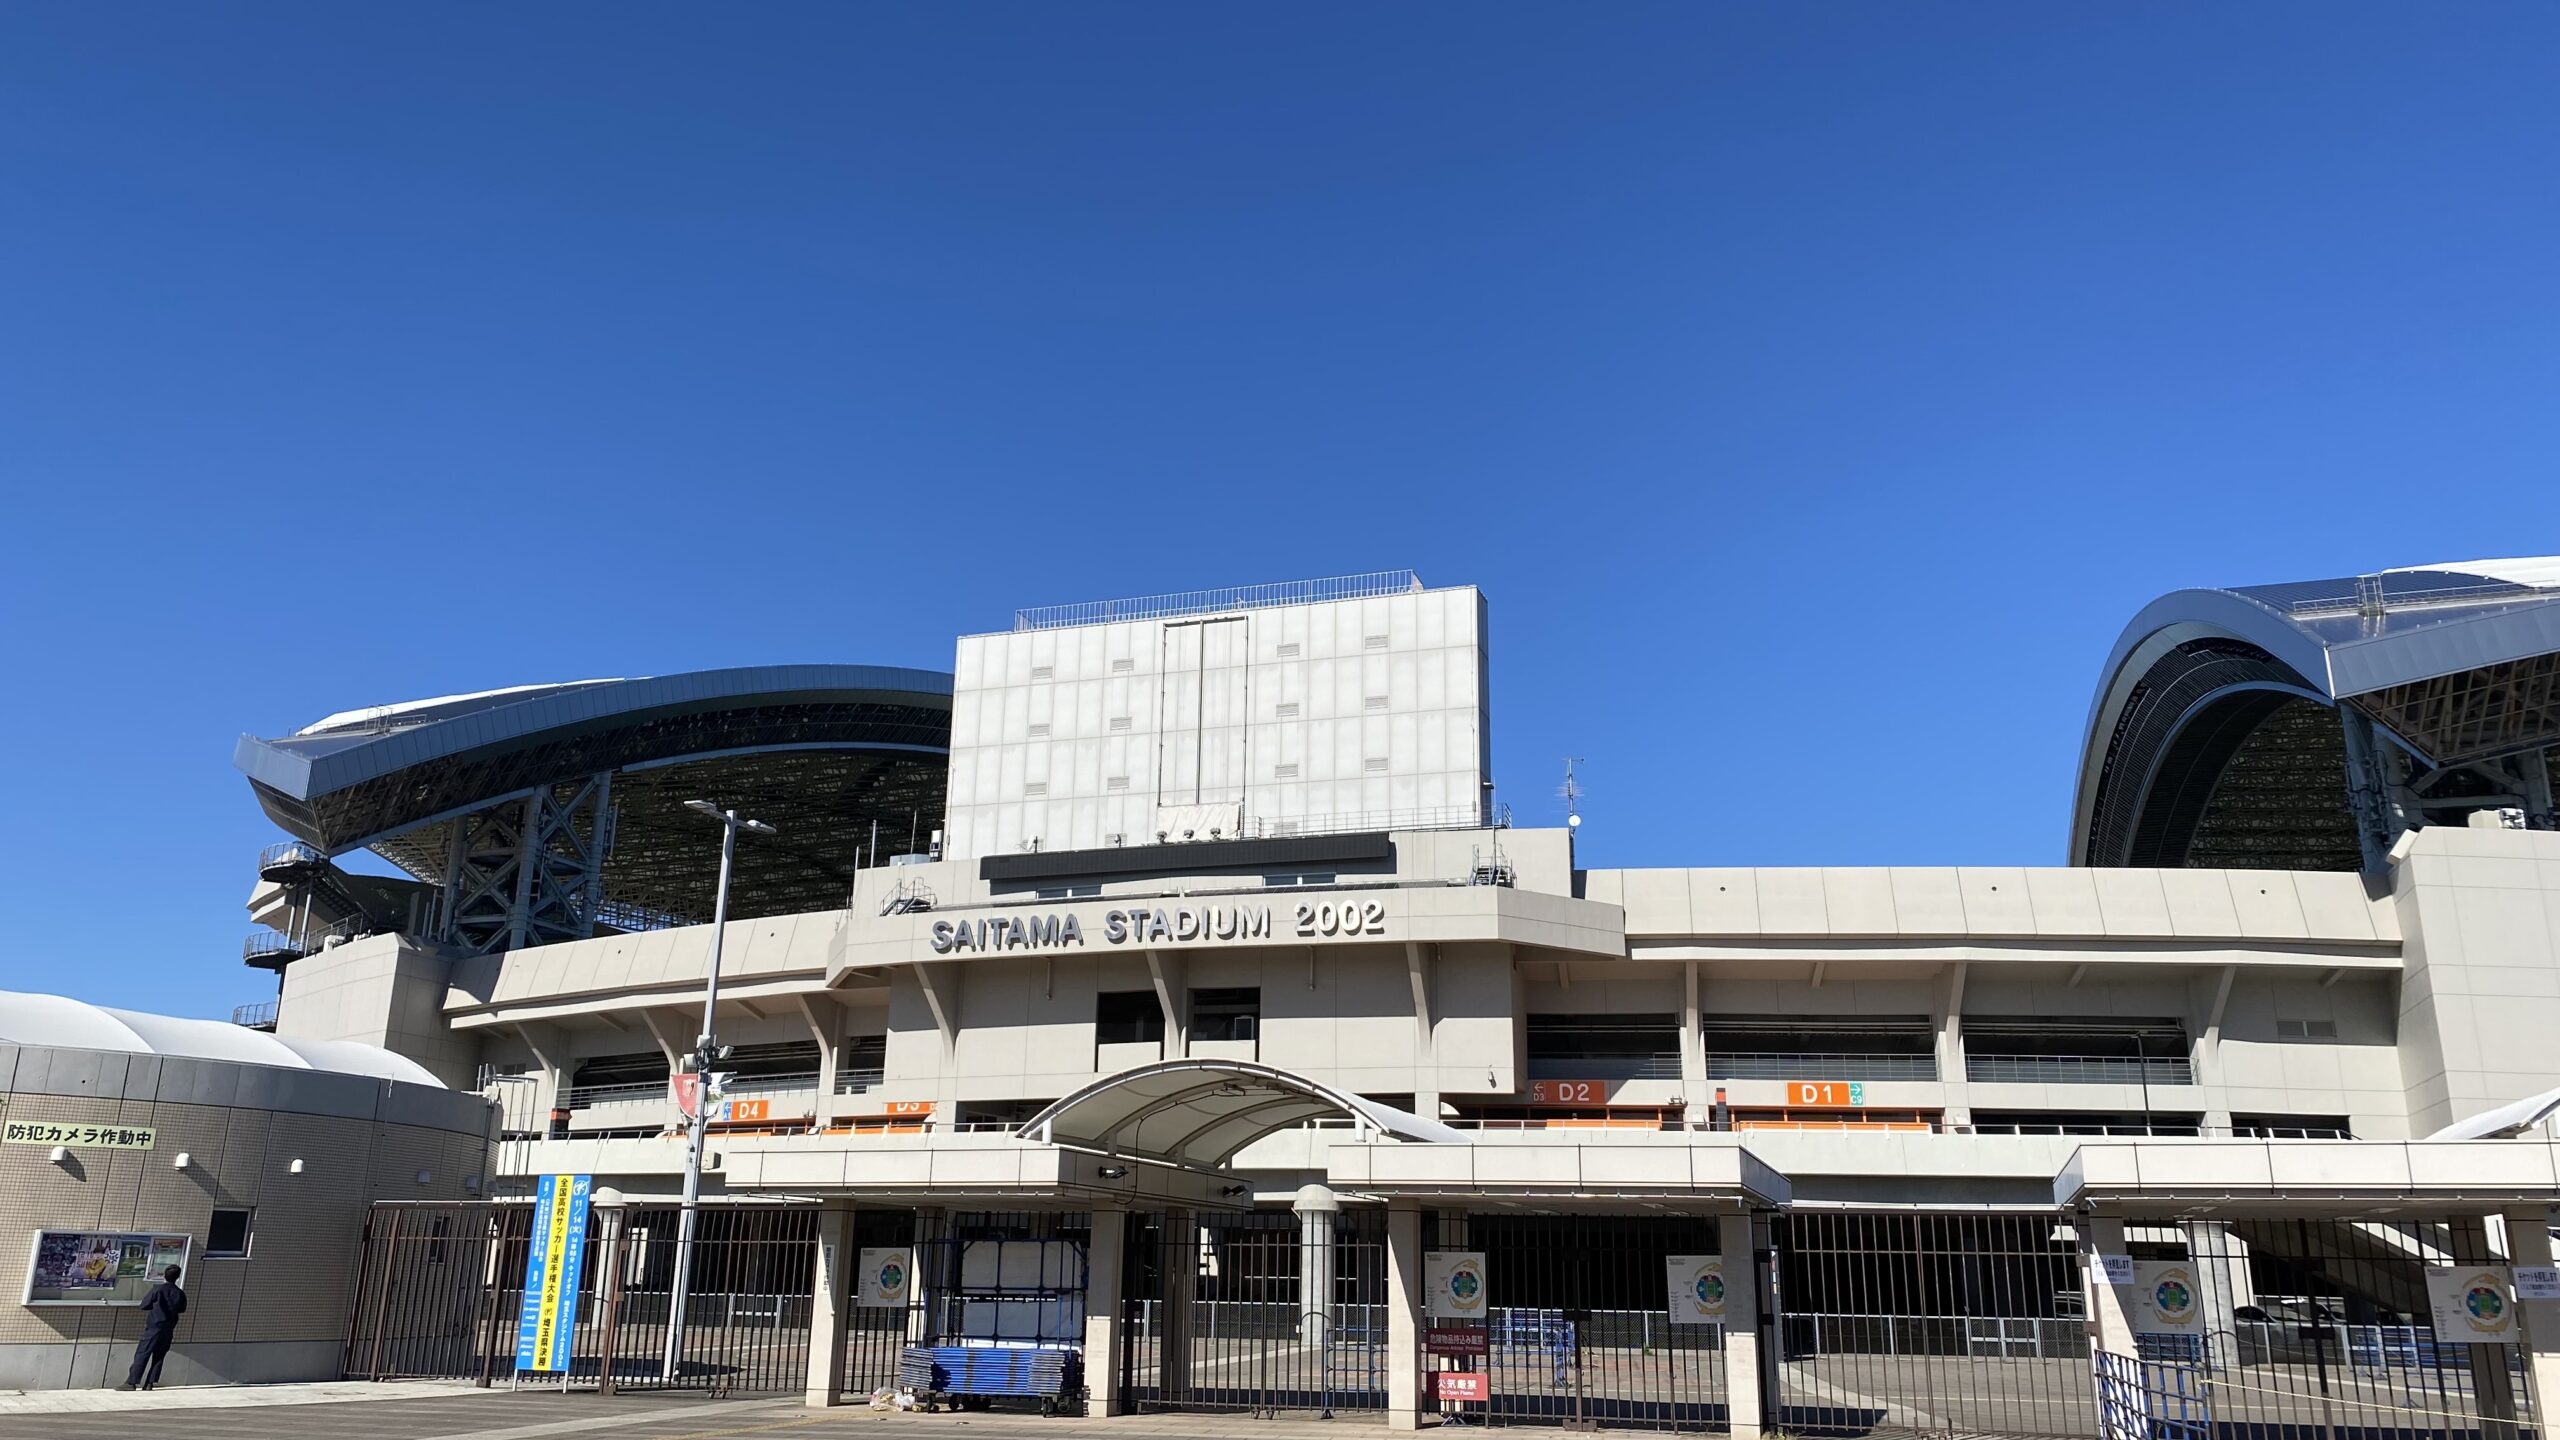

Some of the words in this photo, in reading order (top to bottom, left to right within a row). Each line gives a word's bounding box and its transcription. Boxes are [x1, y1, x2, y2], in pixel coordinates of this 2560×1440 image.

[930, 913, 1084, 953] SAITAMA
[1104, 903, 1270, 944] STADIUM
[1294, 899, 1384, 936] 2002
[1558, 1083, 1590, 1101] D2
[1802, 1085, 1832, 1103] D1
[1851, 1095, 1862, 1104] C9
[739, 1102, 759, 1119] D4
[7, 1124, 152, 1146] 防犯カメラ作動中
[79, 1238, 119, 1251] FINAL
[546, 1177, 569, 1303] 全国高校サッカー選手権大会
[538, 1318, 551, 1367] 埼玉県決勝
